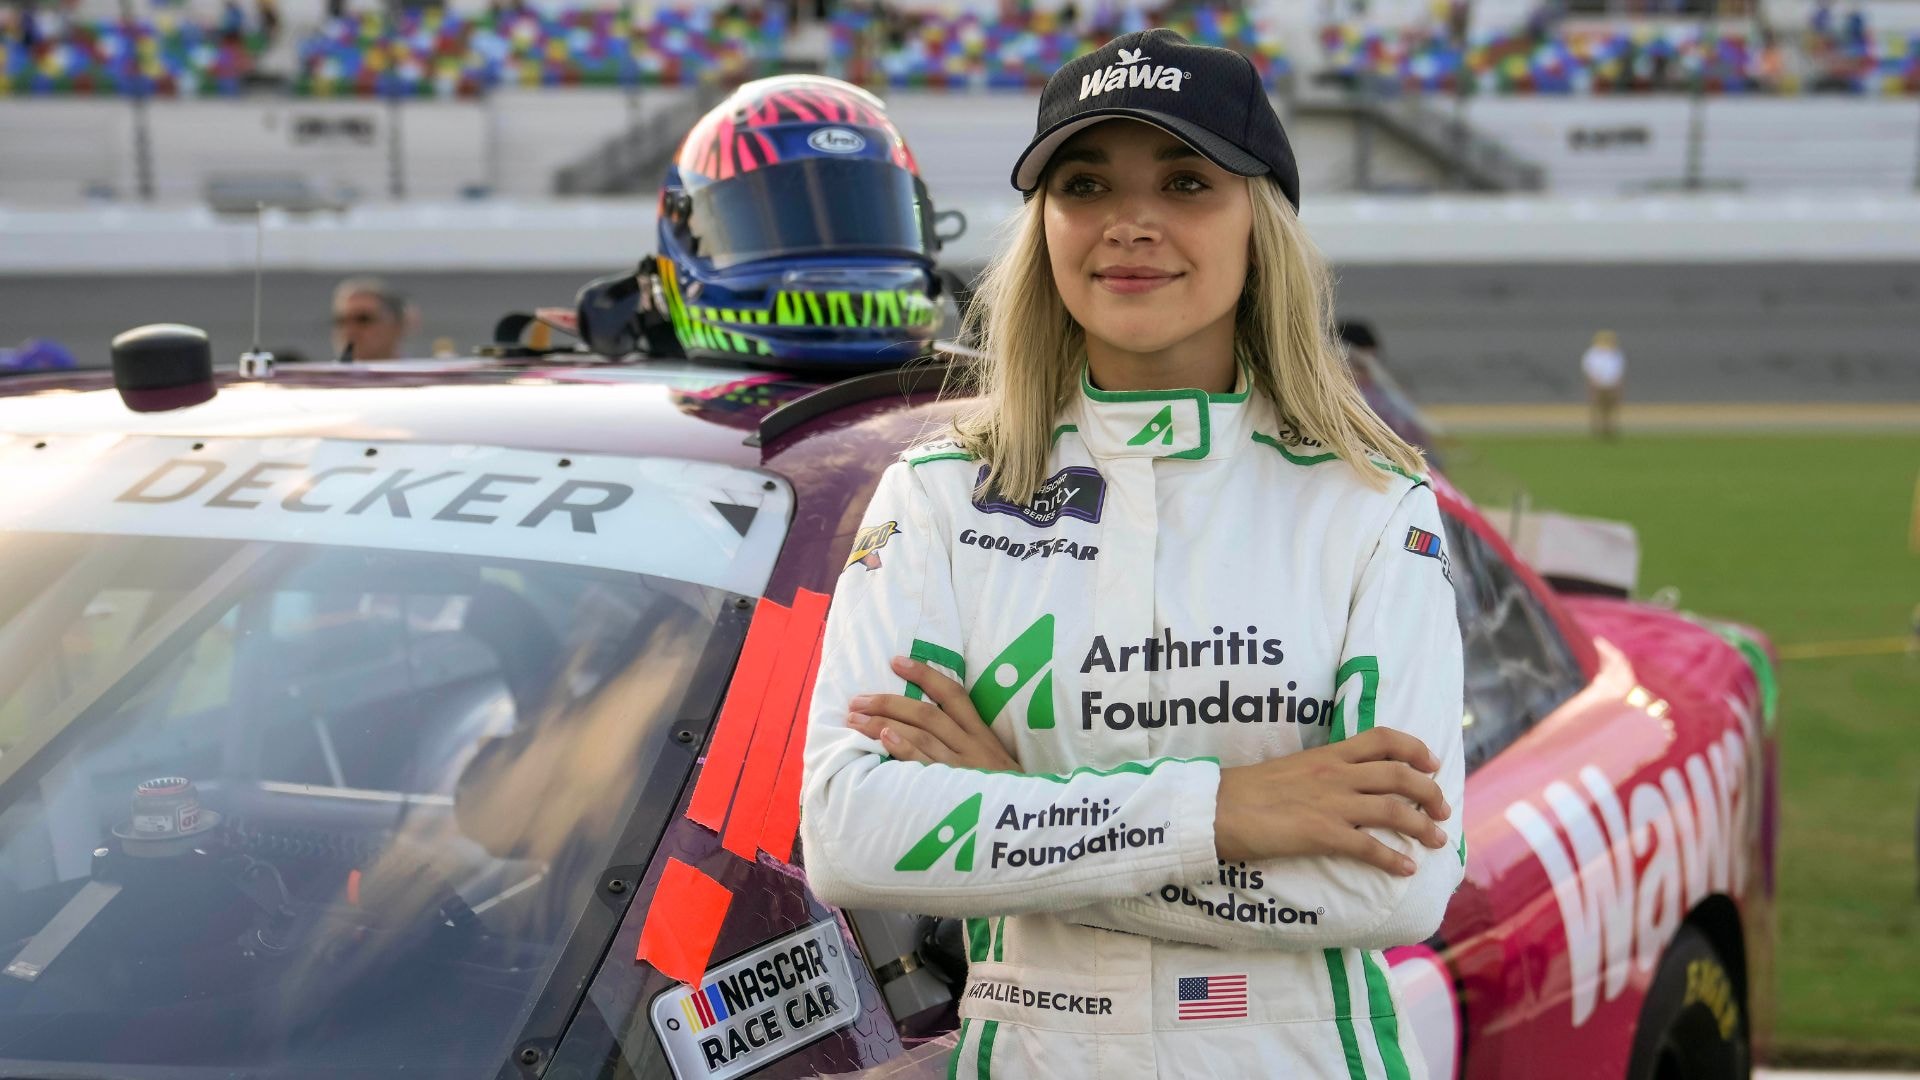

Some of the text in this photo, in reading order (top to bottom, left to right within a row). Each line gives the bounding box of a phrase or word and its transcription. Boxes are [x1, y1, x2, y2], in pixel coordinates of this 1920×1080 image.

[1079, 64, 1183, 101] Wawa
[114, 459, 634, 534] DECKER
[1023, 508, 1057, 522] SERIES
[1033, 487, 1081, 511] nity
[960, 529, 1099, 561] GOODYEAR
[1079, 625, 1284, 674] Arthritis
[1081, 680, 1335, 730] Foundation
[995, 797, 1121, 831] Arthriti
[991, 822, 1165, 869] Foundation
[1160, 884, 1318, 925] oundation
[717, 938, 828, 1017] NASCAR
[1022, 989, 1113, 1015] DECKER
[701, 983, 840, 1071] RACE CAR
